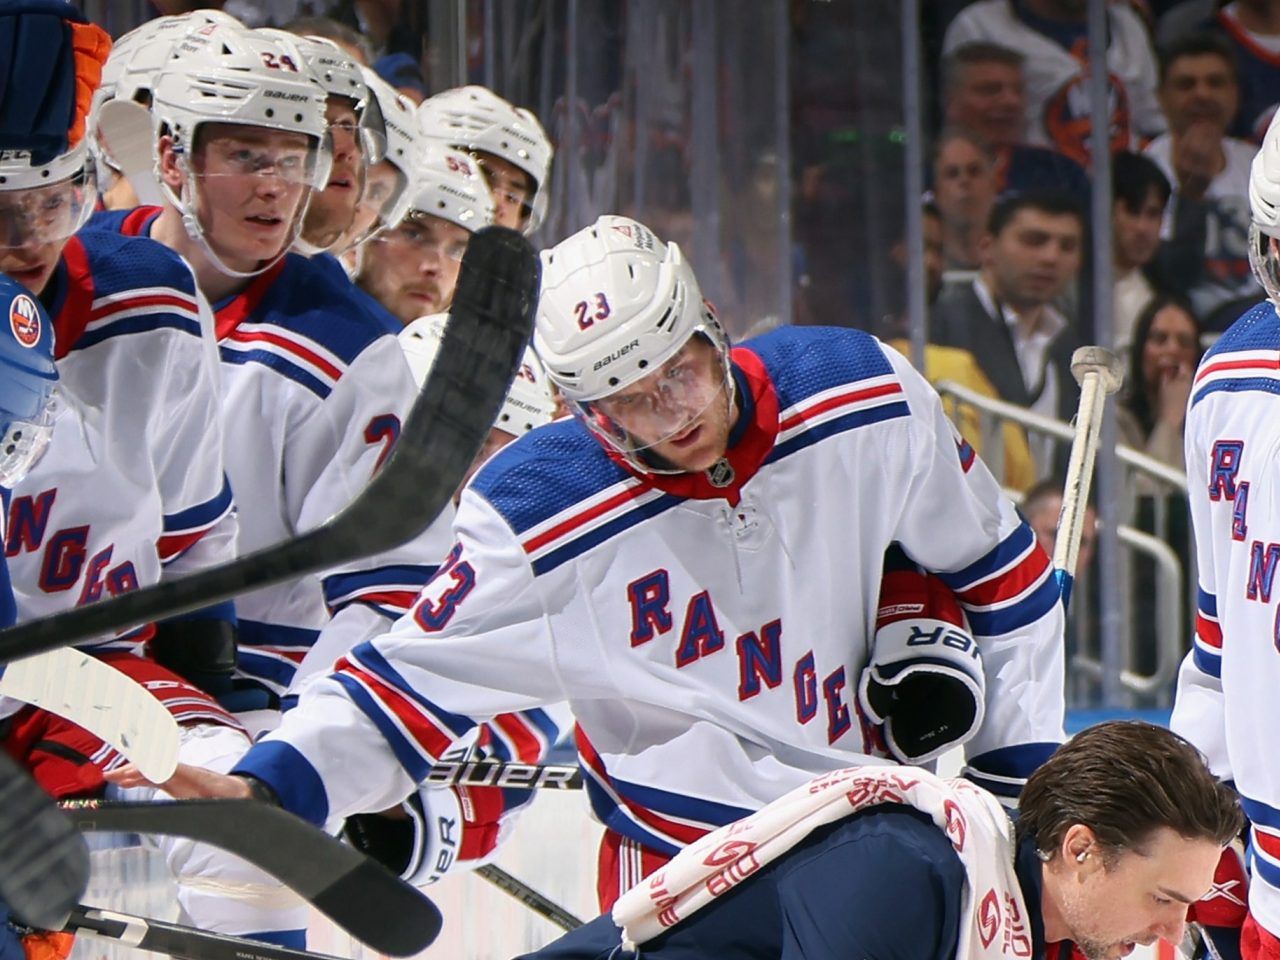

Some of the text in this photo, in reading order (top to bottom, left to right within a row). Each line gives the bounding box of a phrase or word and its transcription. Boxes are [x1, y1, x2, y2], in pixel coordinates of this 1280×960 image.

[263, 89, 309, 104] BAUER
[573, 292, 611, 332] 23
[593, 338, 641, 373] BAUER
